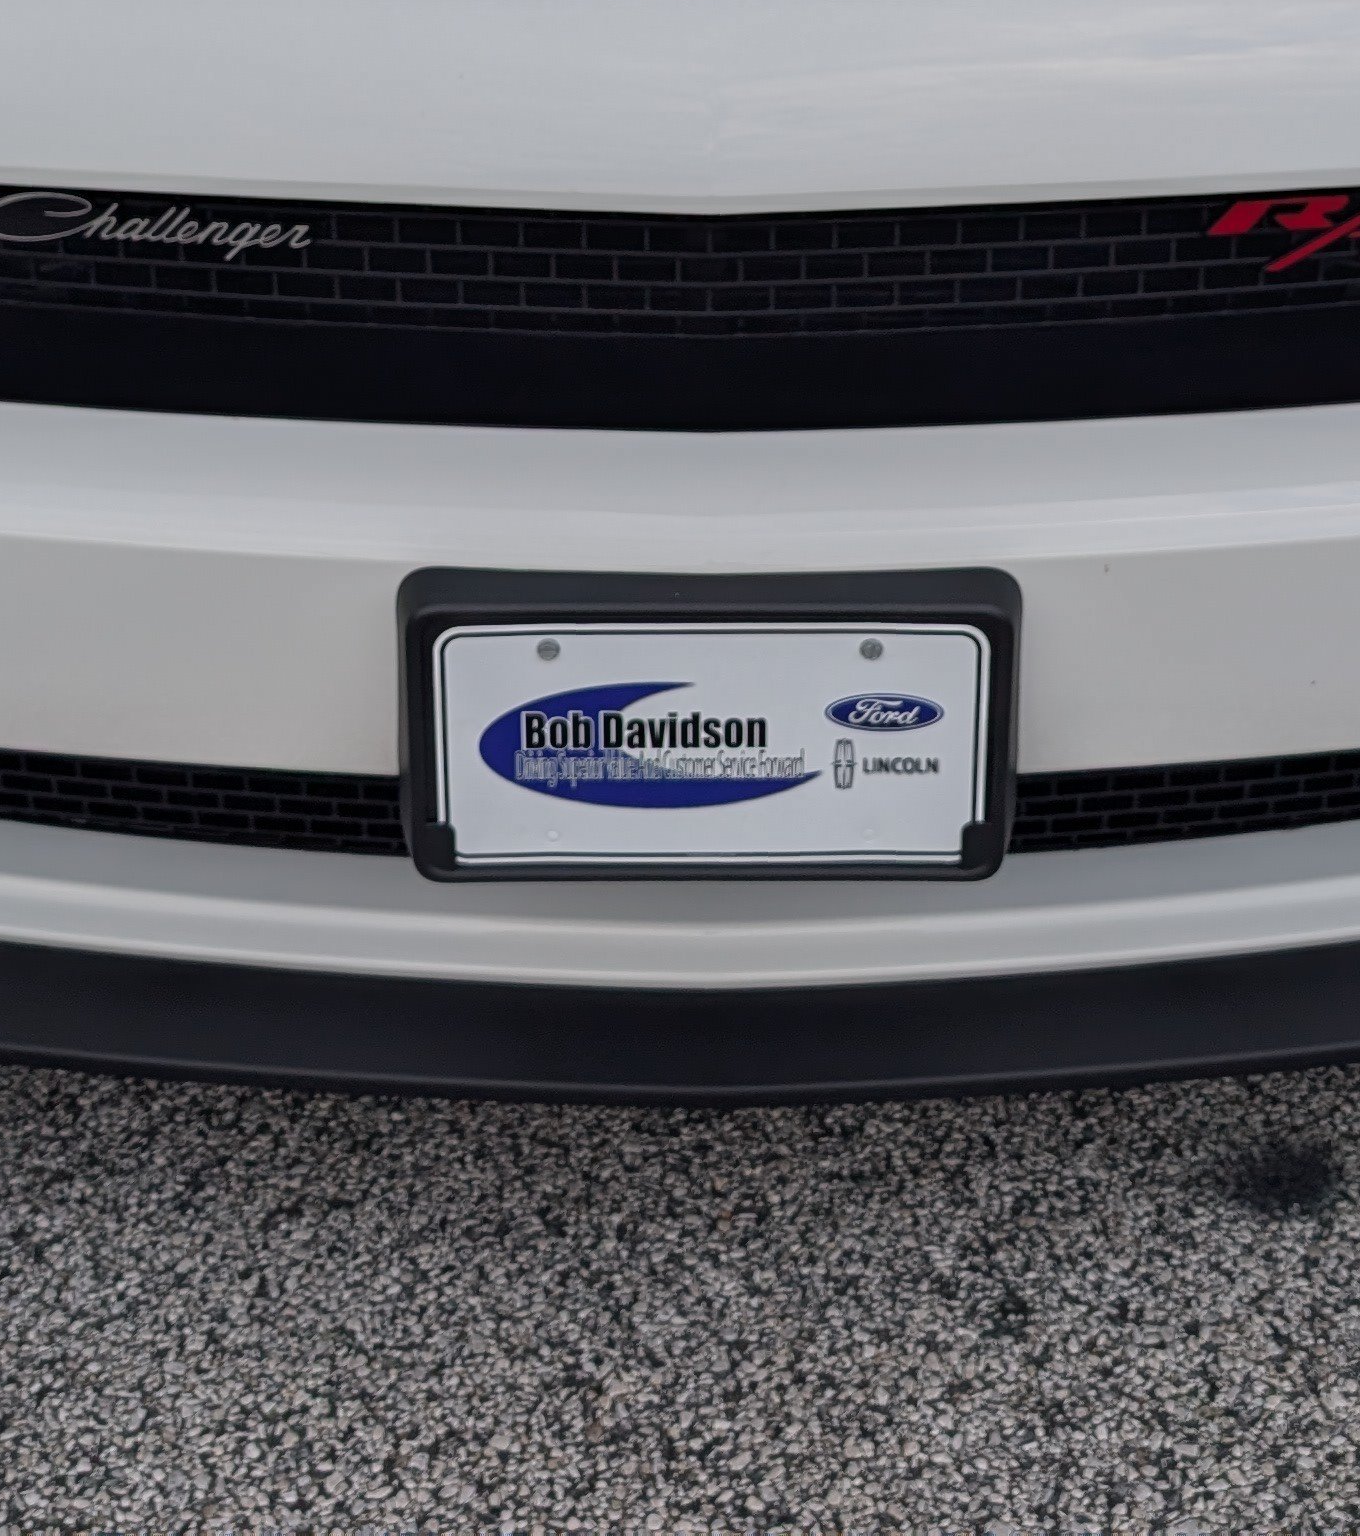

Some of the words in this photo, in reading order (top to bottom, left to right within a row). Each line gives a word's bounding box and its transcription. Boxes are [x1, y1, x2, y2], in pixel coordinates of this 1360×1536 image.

[847, 698, 921, 725] Ford
[522, 711, 593, 750] Bob
[600, 710, 767, 750] Davidson
[862, 756, 939, 774] LINCOLN
